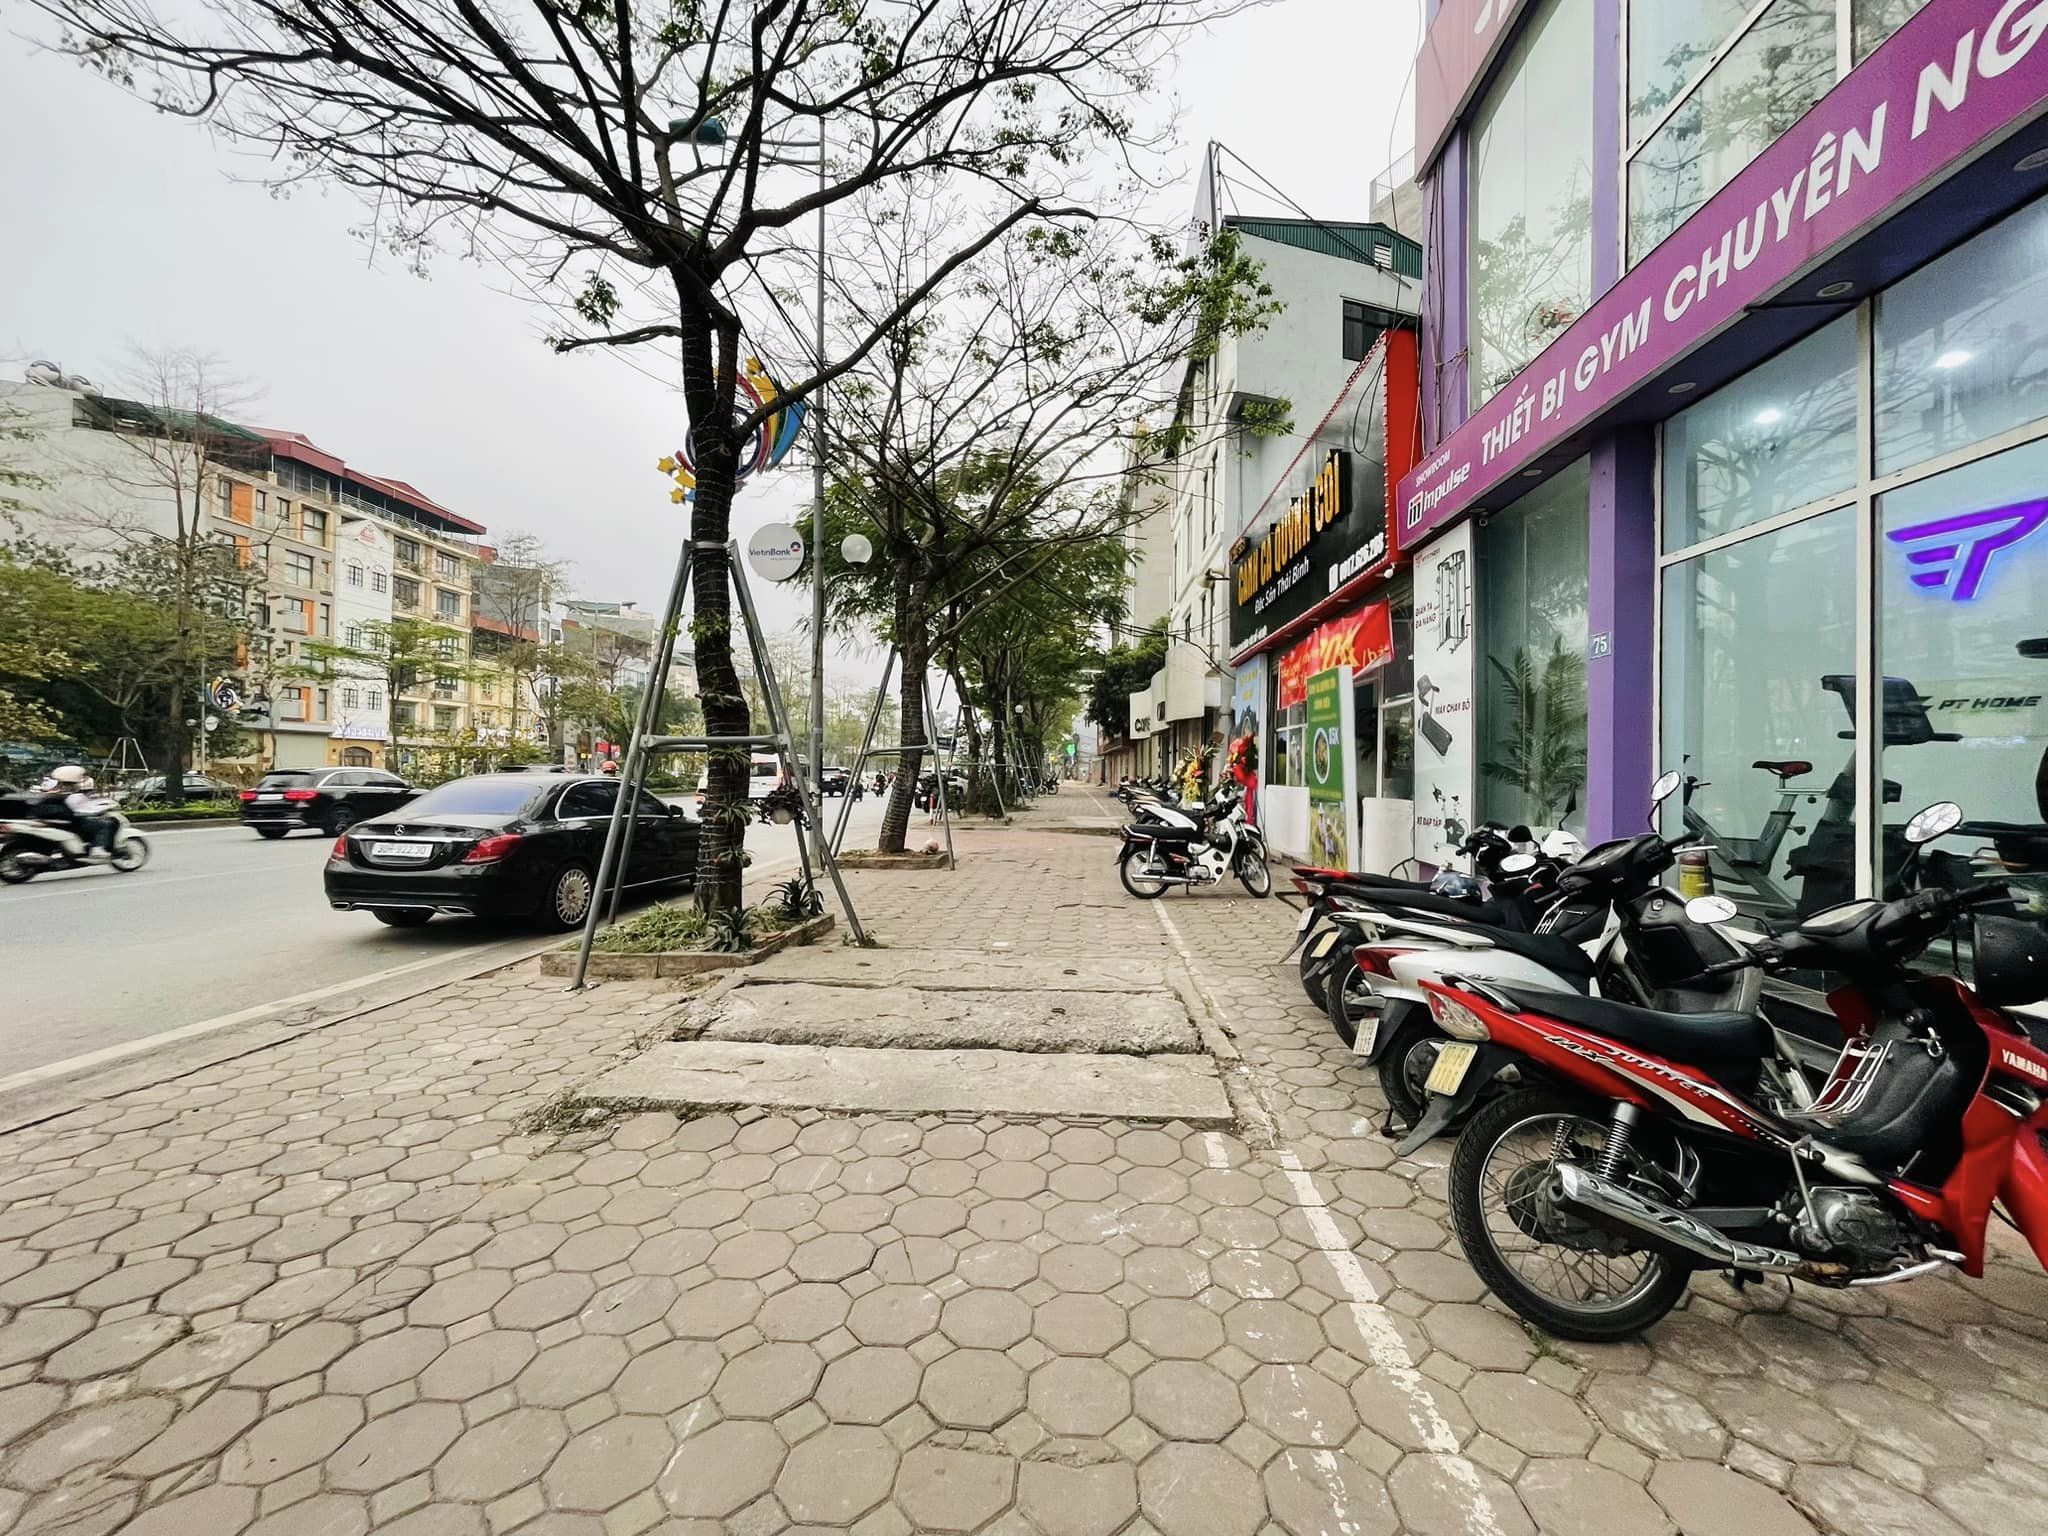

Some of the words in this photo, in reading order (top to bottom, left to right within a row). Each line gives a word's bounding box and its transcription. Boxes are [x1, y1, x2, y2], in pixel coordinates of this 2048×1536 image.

[1482, 384, 1536, 466] THIẾT
[1541, 368, 1566, 421] BỊ
[1574, 296, 1652, 392] GYM
[1664, 100, 1888, 322] CHUYÊN
[1415, 448, 1451, 488] SHOWROOM
[1277, 574, 1292, 598] Thái
[1292, 555, 1310, 586] Bình
[1592, 636, 1607, 654] 75
[1938, 699, 1970, 710] PT
[1971, 695, 2042, 709] HOME
[2002, 1048, 2048, 1081] YAMAHA
